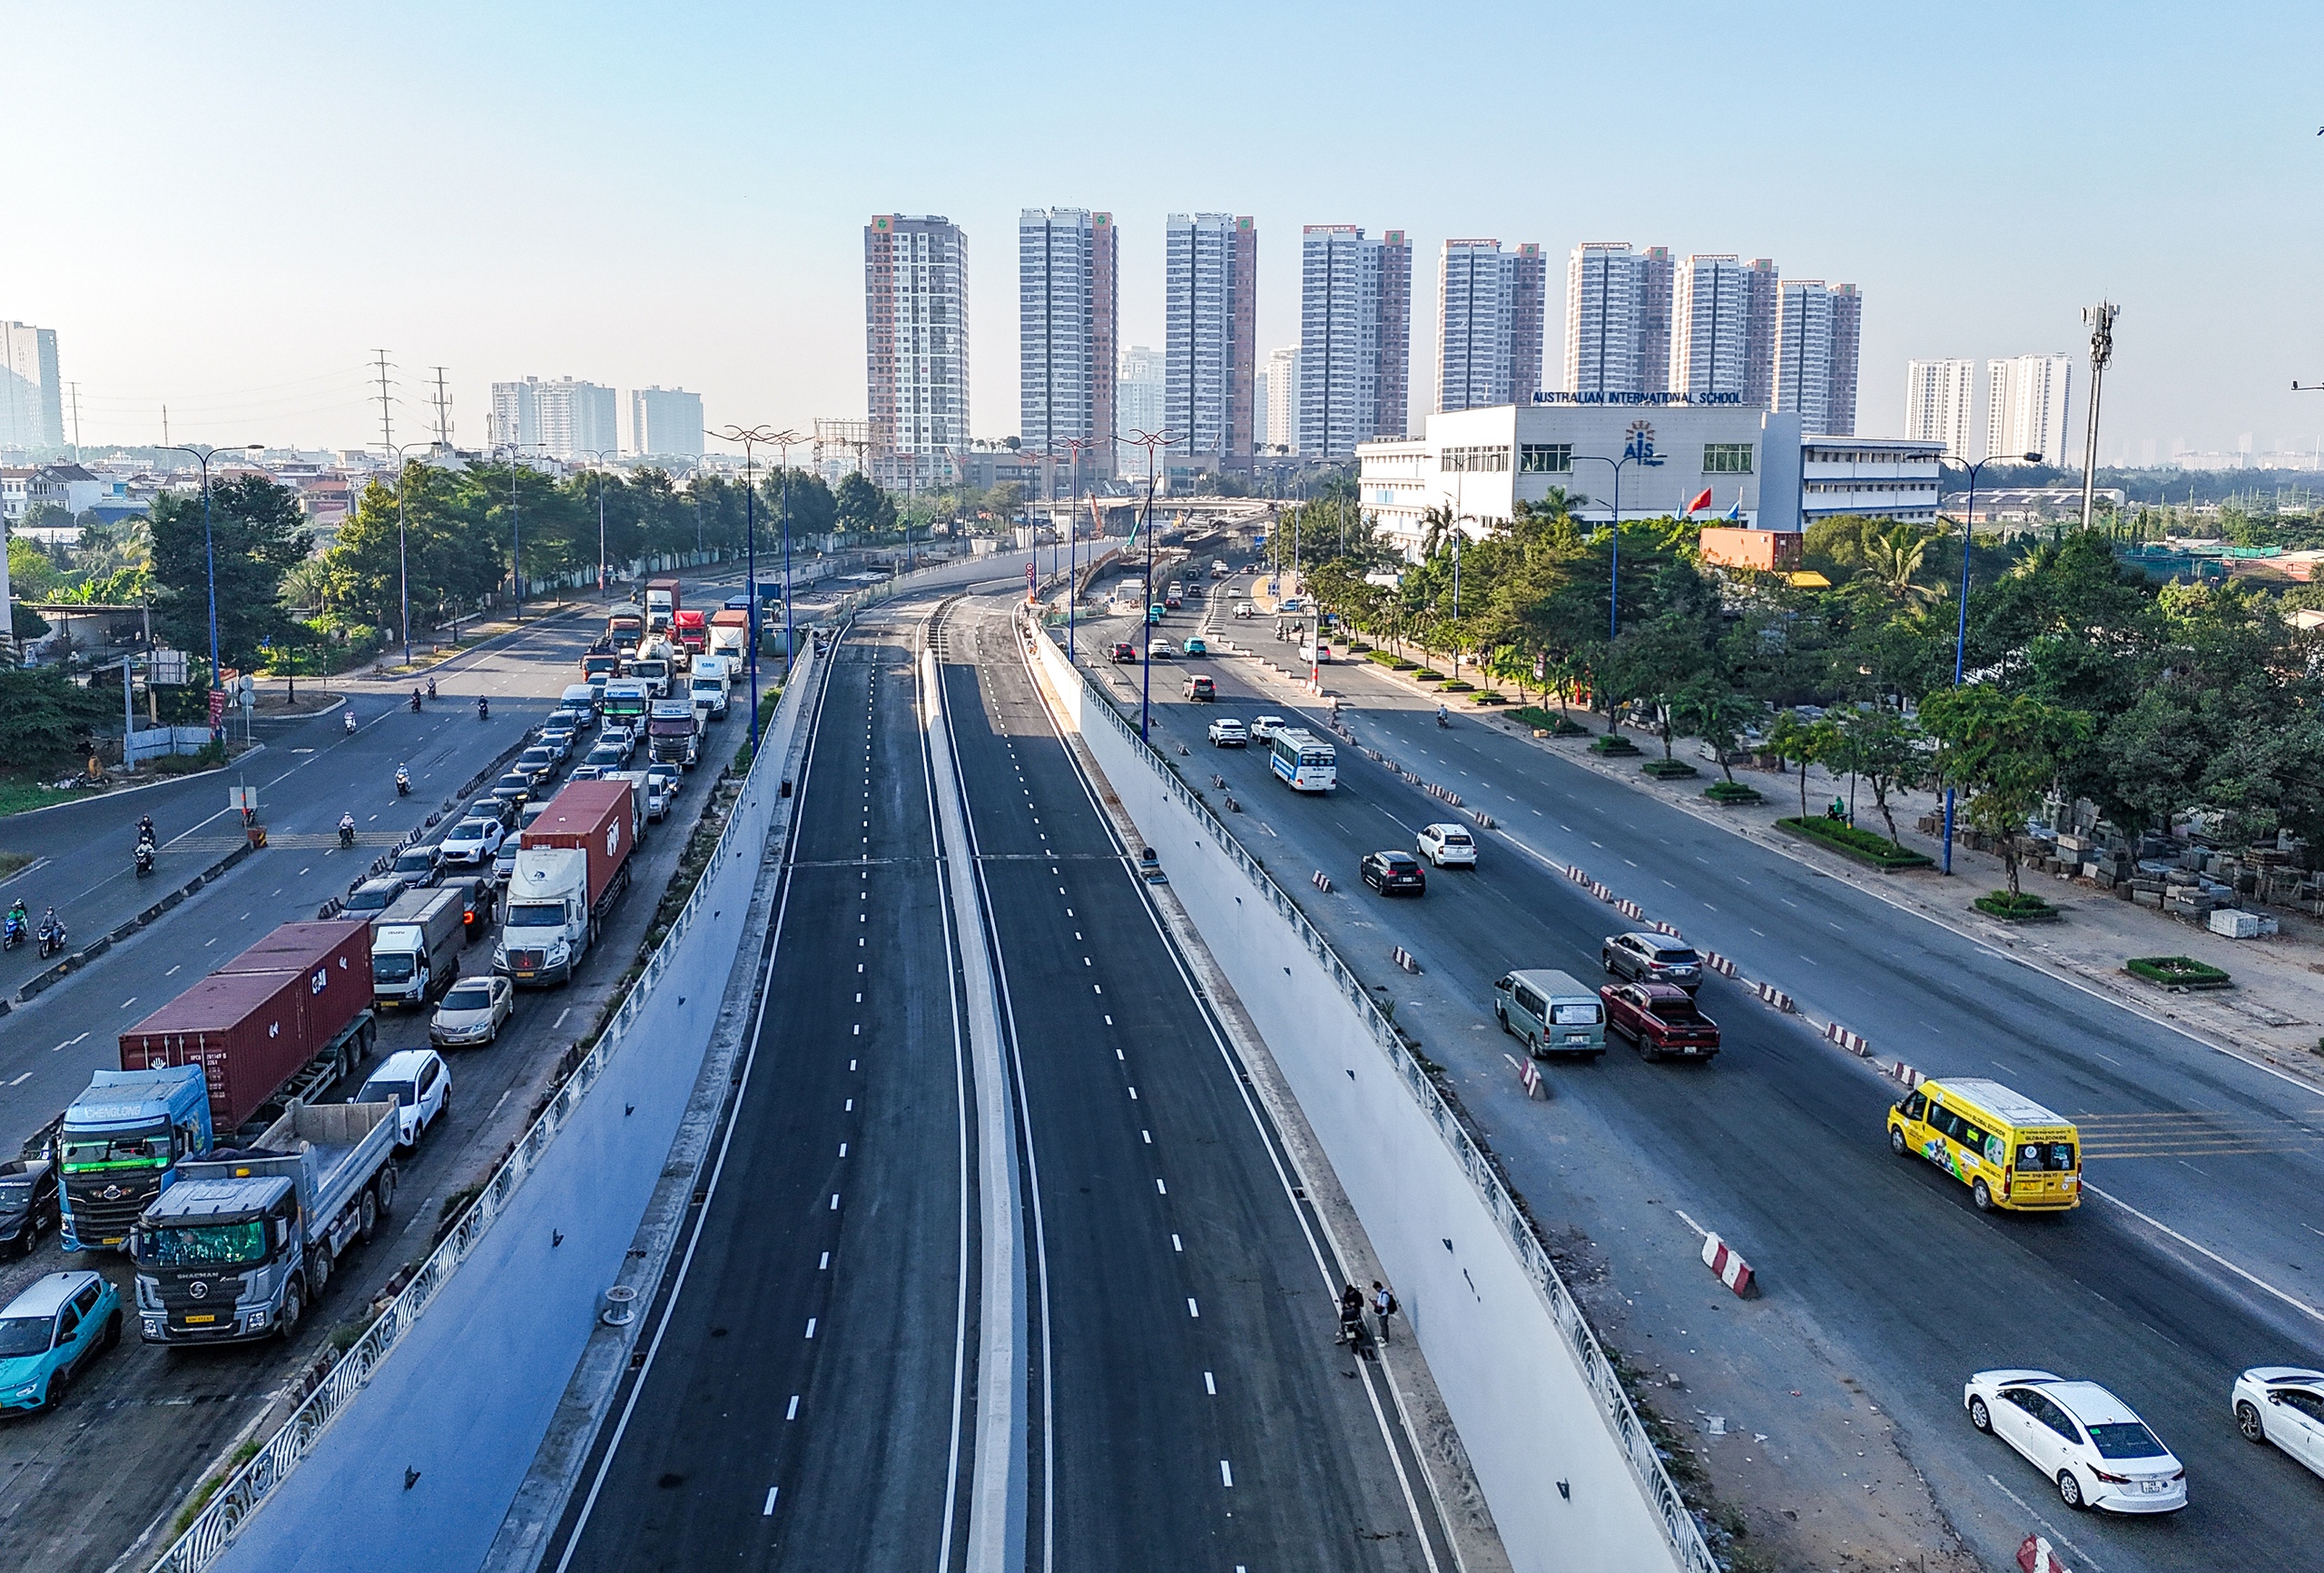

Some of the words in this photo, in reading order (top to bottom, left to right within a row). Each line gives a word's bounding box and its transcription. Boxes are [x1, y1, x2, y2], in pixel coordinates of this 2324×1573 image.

[1532, 391, 1604, 404] AUSTRALIAN
[1608, 391, 1695, 404] INTERNATIONAL
[1699, 391, 1742, 404] SCHOOL
[84, 1106, 141, 1118] CHENGLONG
[177, 1272, 219, 1280] SHACMAN
